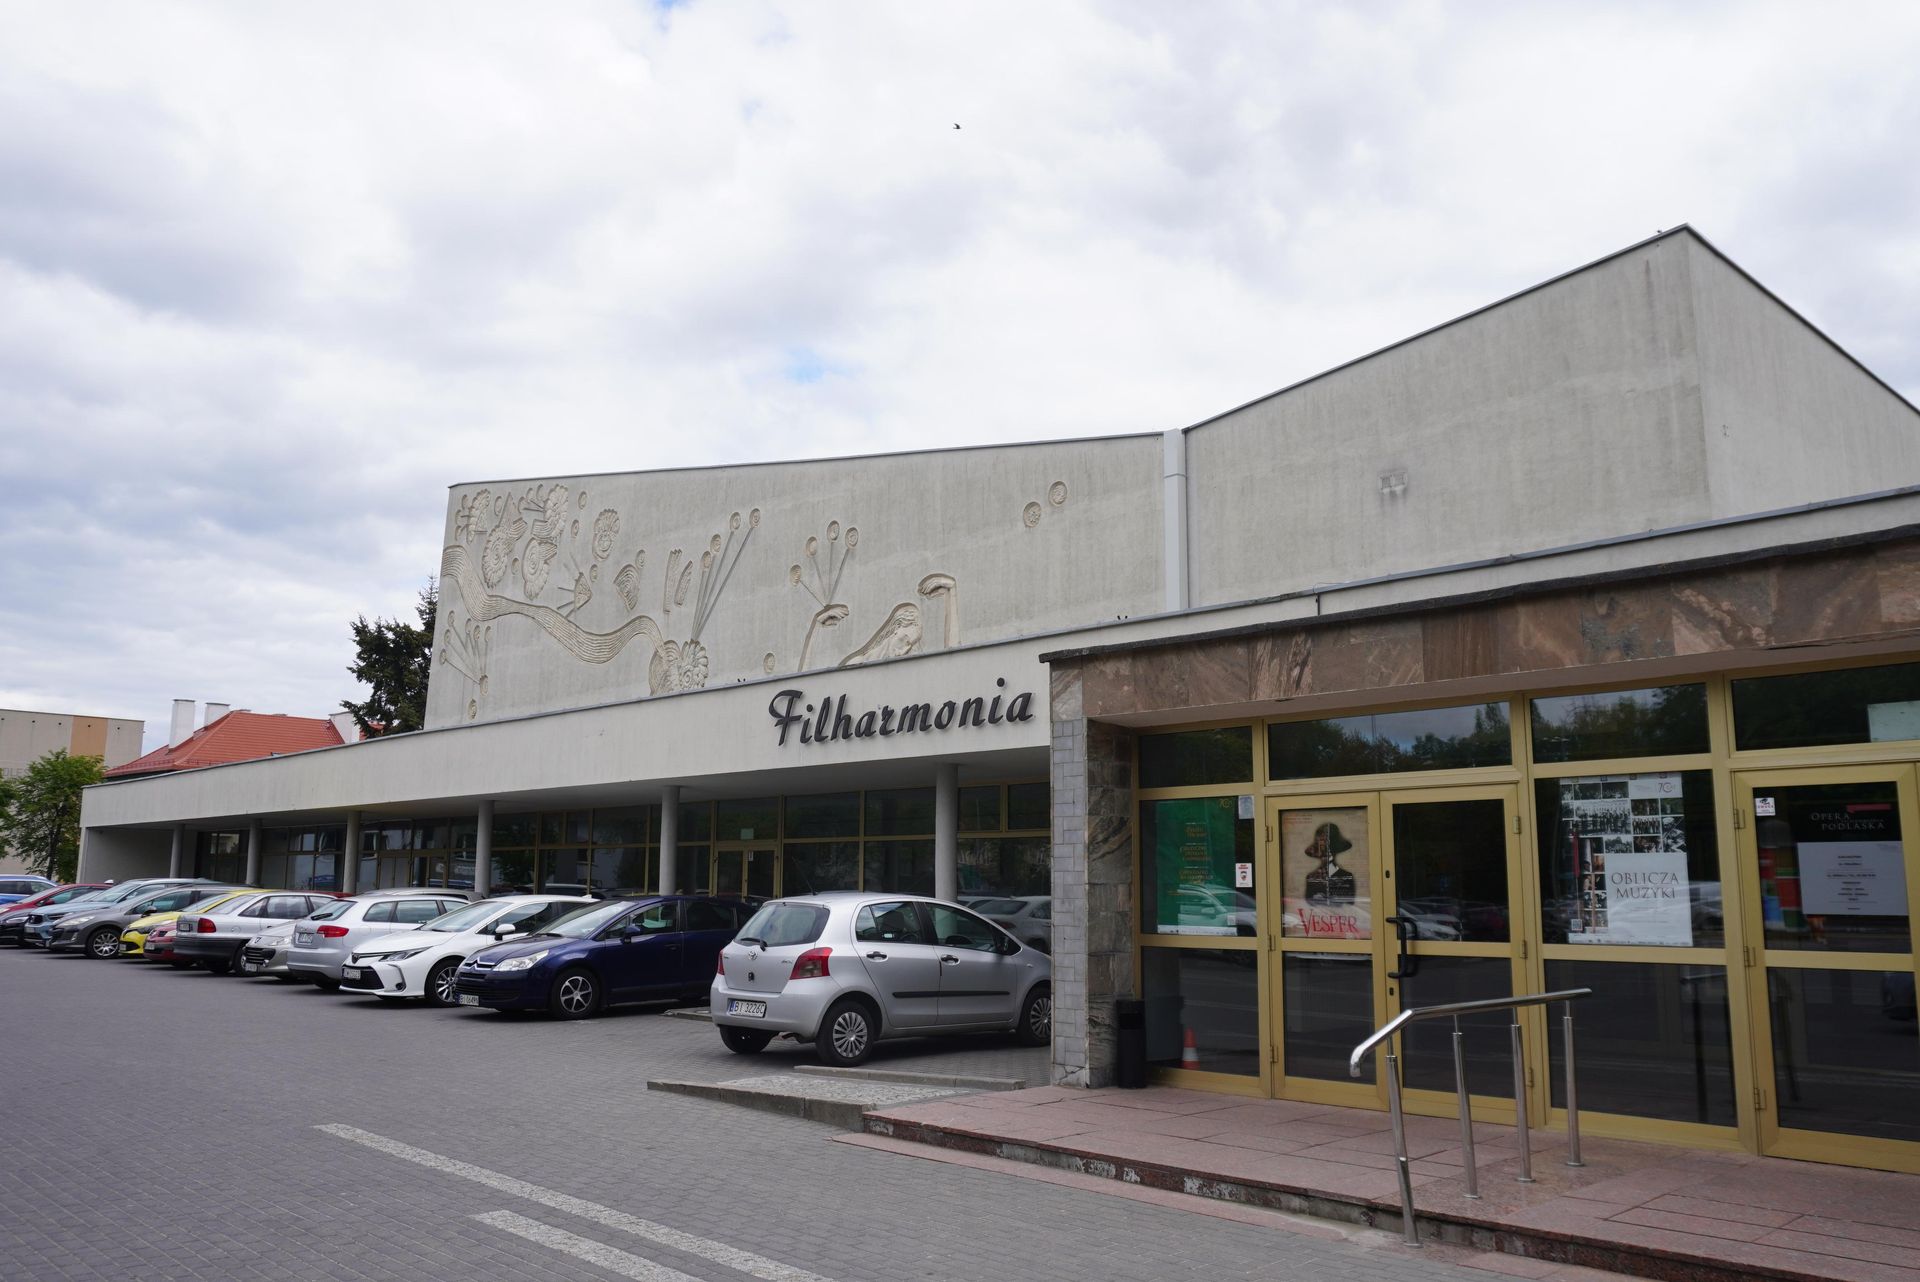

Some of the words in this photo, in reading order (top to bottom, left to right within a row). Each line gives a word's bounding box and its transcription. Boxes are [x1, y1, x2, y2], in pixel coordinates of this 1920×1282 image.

[768, 677, 1033, 746] Filharmonia
[1811, 812, 1850, 821] OPERA
[1611, 872, 1679, 885] OBLICZA
[1616, 886, 1676, 899] MUZYKI
